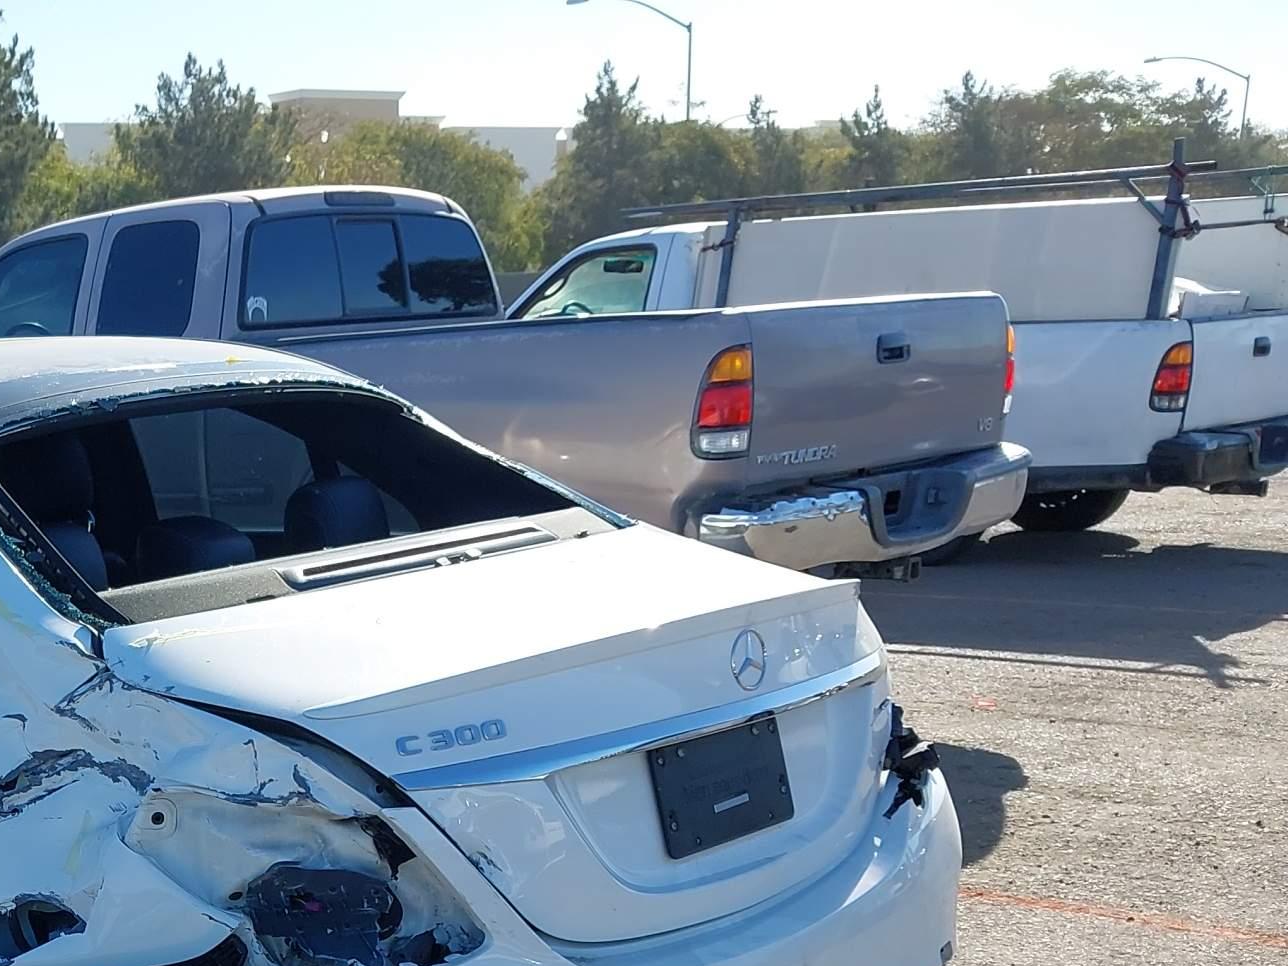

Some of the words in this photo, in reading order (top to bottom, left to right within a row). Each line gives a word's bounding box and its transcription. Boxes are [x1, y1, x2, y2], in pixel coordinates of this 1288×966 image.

[781, 444, 837, 465] TUNDRA
[395, 735, 423, 757] C
[427, 718, 508, 751] 300
